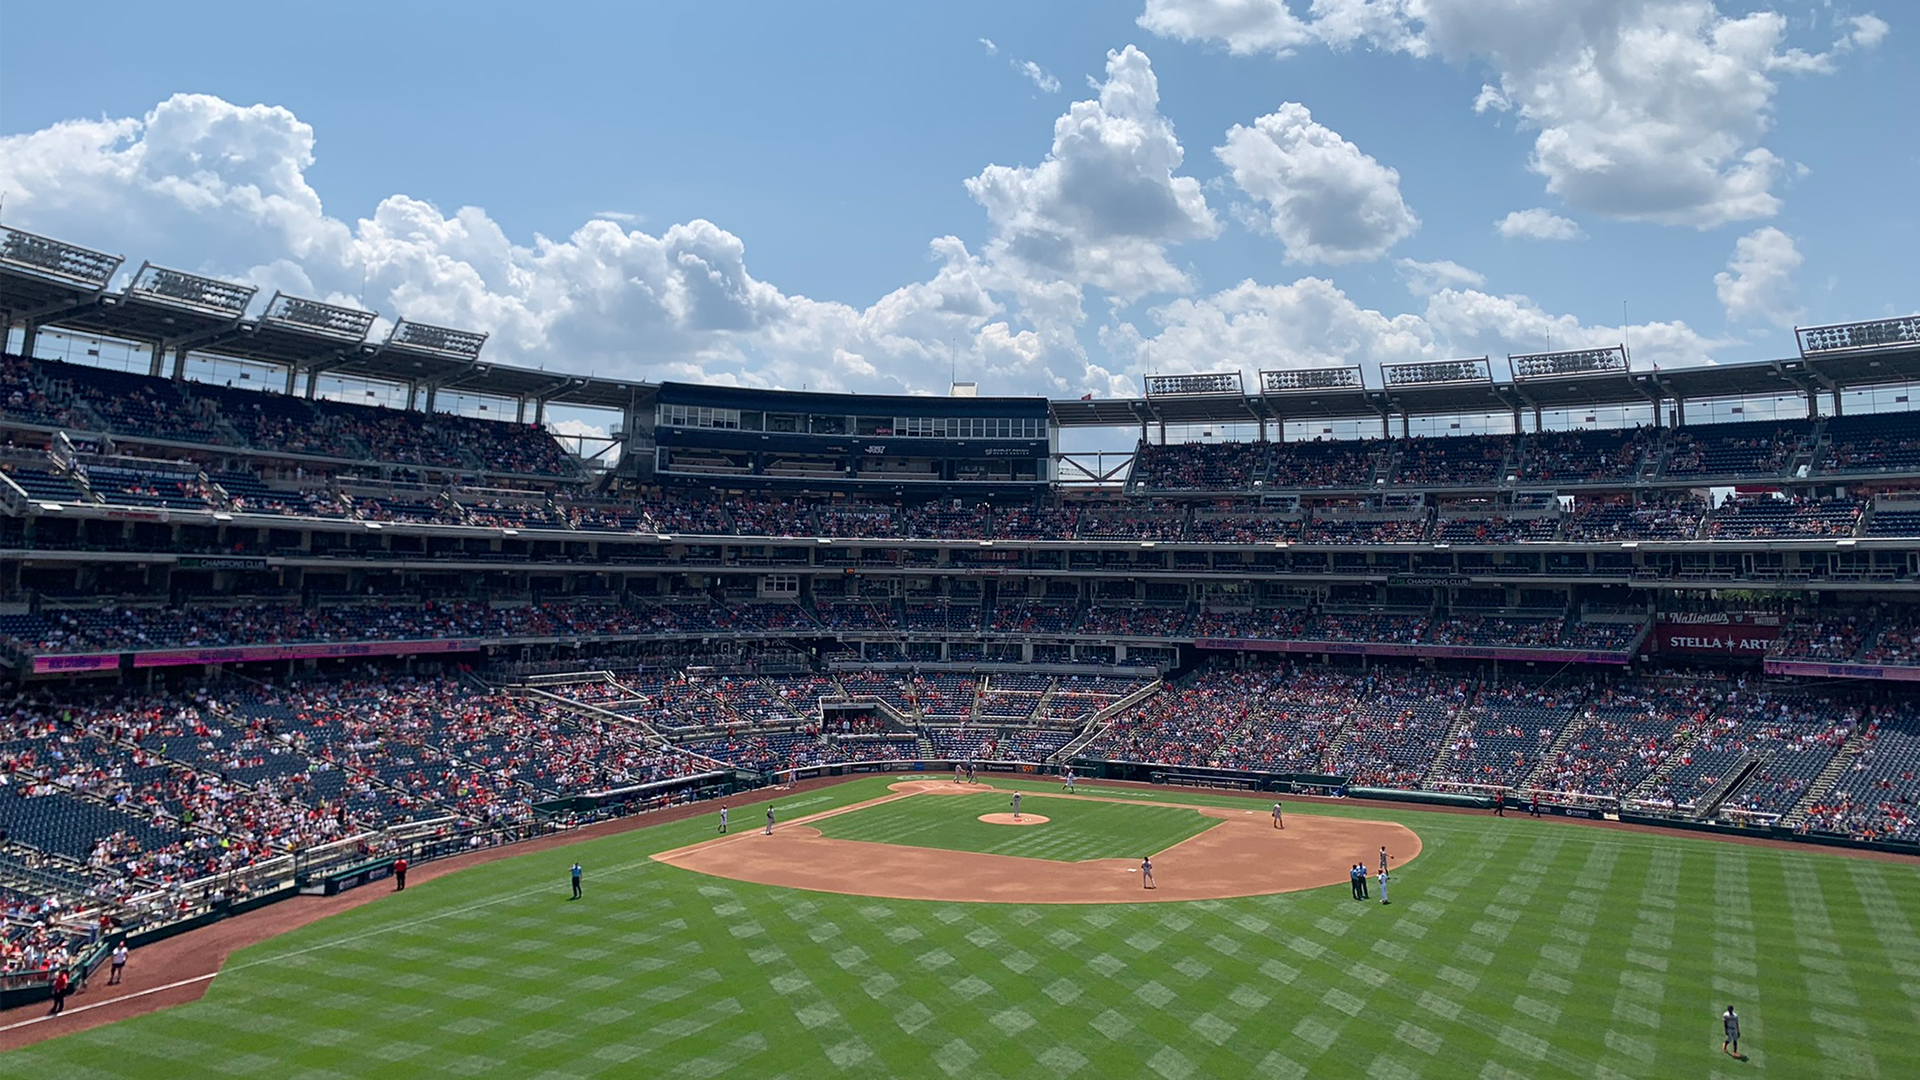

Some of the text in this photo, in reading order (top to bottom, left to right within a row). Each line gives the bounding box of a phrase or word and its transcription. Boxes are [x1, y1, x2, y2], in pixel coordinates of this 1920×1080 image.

[200, 559, 244, 568] CHAMPIONS
[245, 560, 265, 569] CLUB
[1406, 578, 1448, 586] CHAMPIONS
[1449, 578, 1469, 586] CLUB
[1669, 612, 1729, 624] Nationals
[1670, 636, 1722, 648] STELLA
